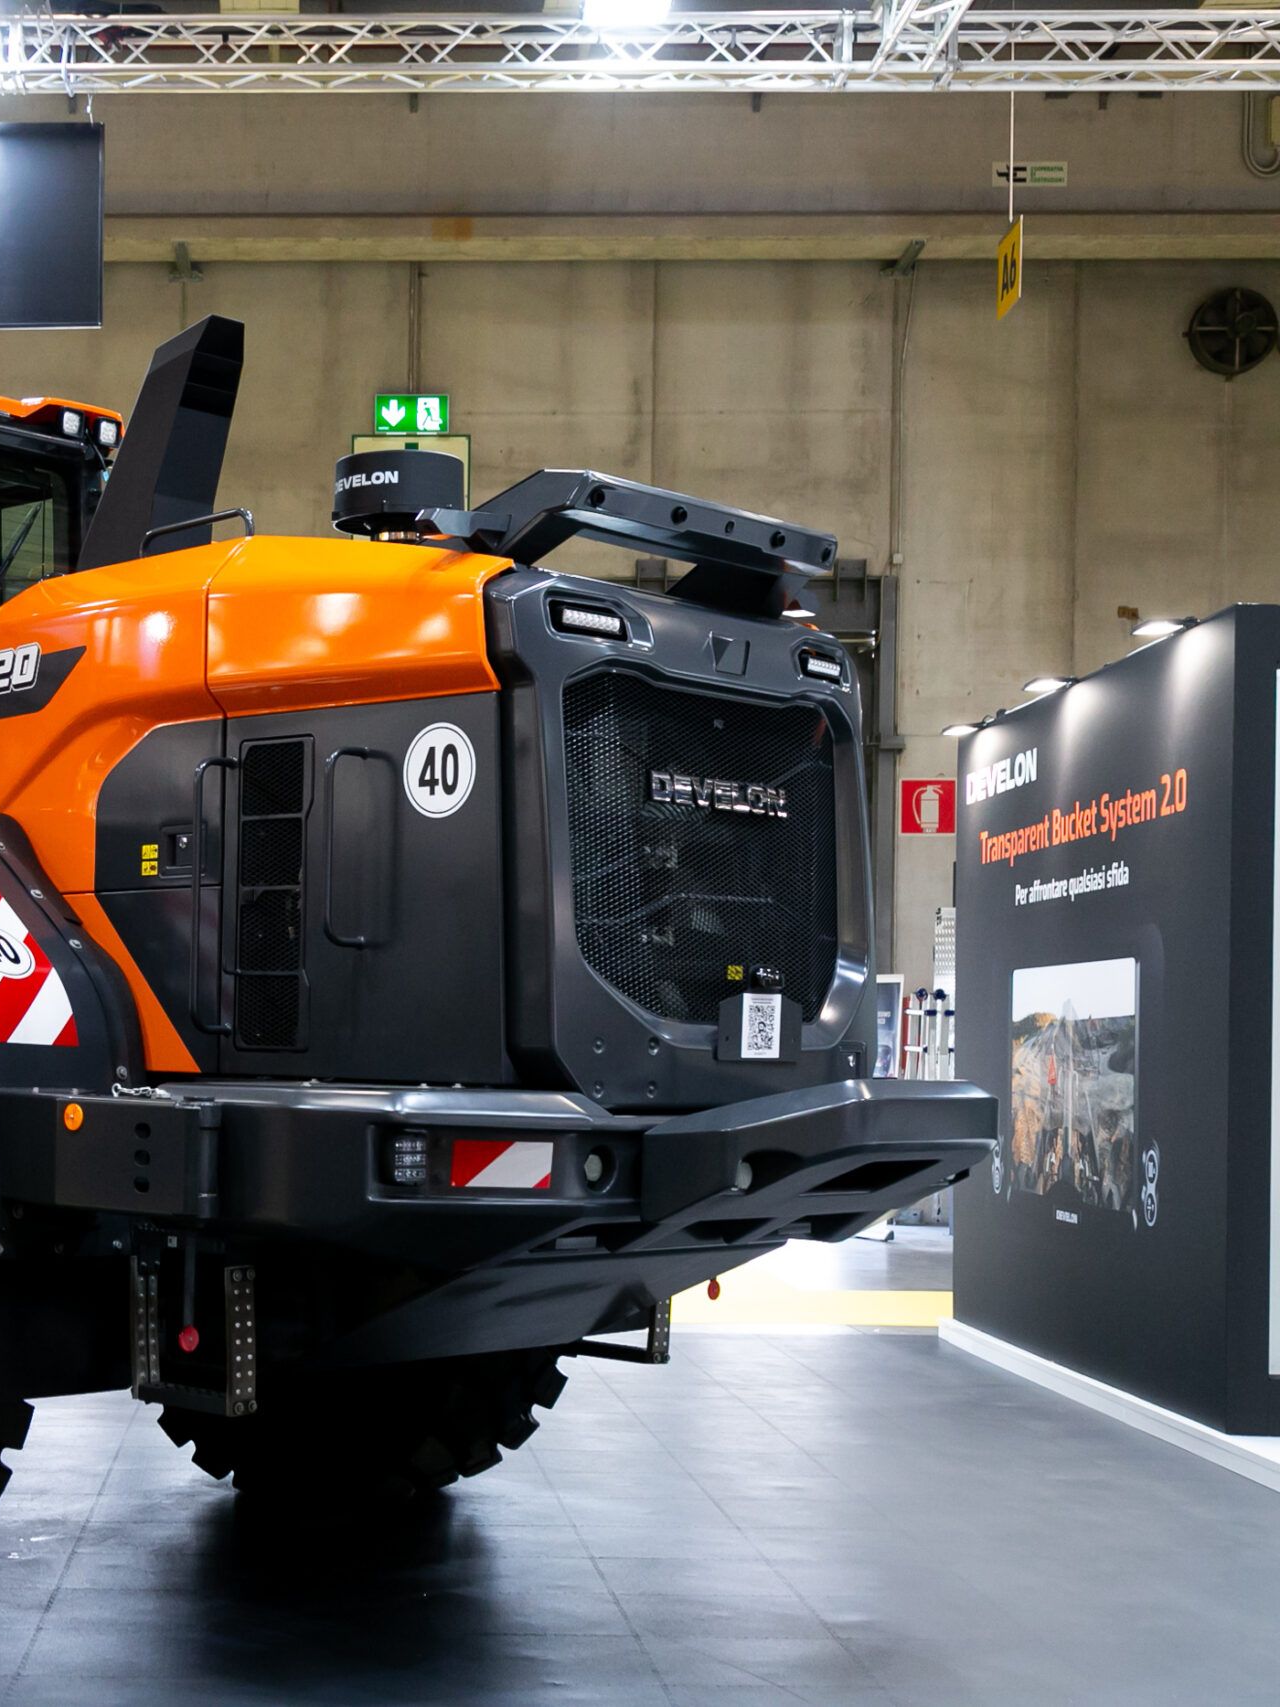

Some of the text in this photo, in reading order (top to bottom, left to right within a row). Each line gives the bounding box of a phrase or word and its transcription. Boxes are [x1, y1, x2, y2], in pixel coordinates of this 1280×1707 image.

[1000, 241, 1017, 302] A6
[335, 470, 399, 495] EVELON
[418, 743, 459, 796] 40
[651, 771, 788, 818] DEVELON
[965, 747, 1038, 805] DEVELON
[979, 768, 1188, 867] Transparent Bucket System 2.0
[1015, 860, 1129, 906] Per affrontare qualsiasi sfida
